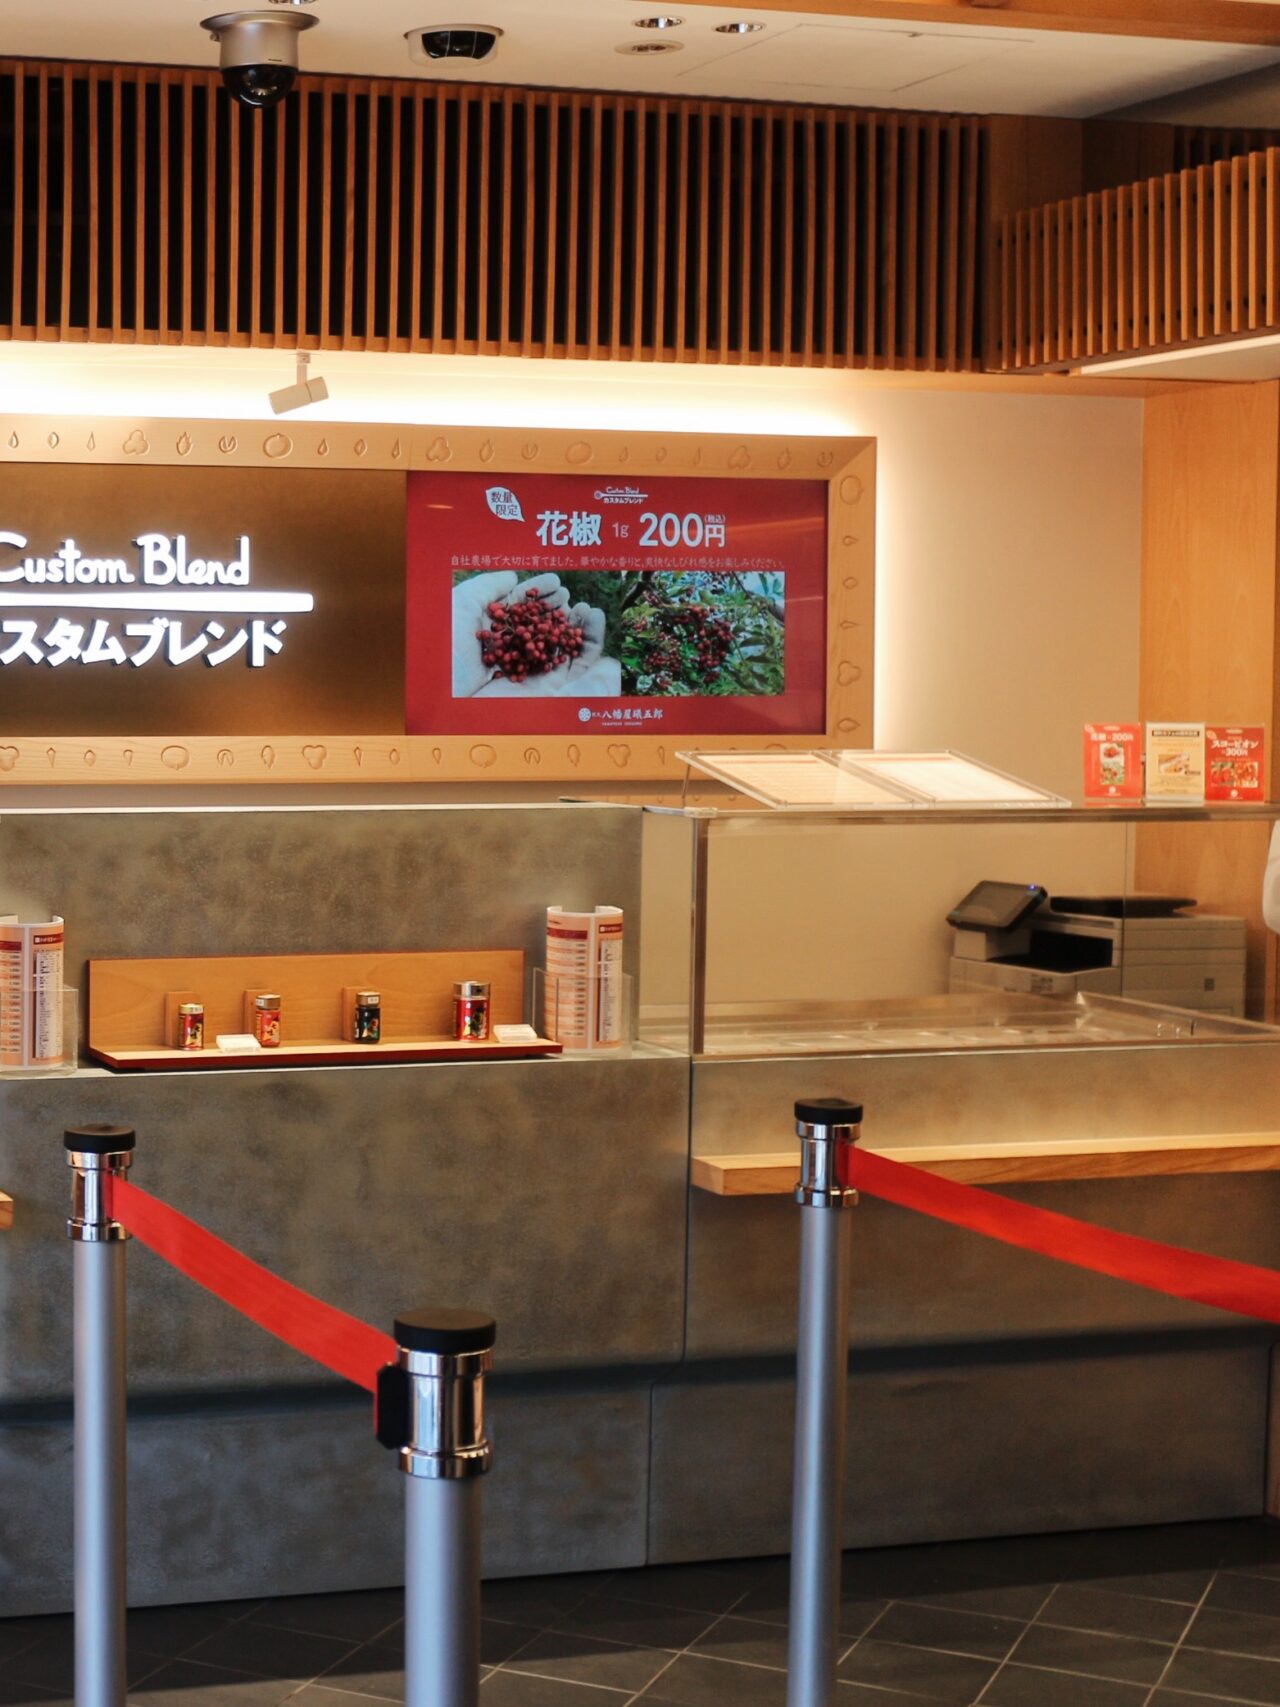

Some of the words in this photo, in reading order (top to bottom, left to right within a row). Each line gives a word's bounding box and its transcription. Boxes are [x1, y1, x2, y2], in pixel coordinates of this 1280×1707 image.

[490, 491, 513, 504] 数量
[495, 503, 519, 517] 限定
[535, 509, 603, 547] 花椒
[611, 521, 630, 538] 1g
[638, 512, 726, 548] 200円
[133, 534, 251, 587] Blend
